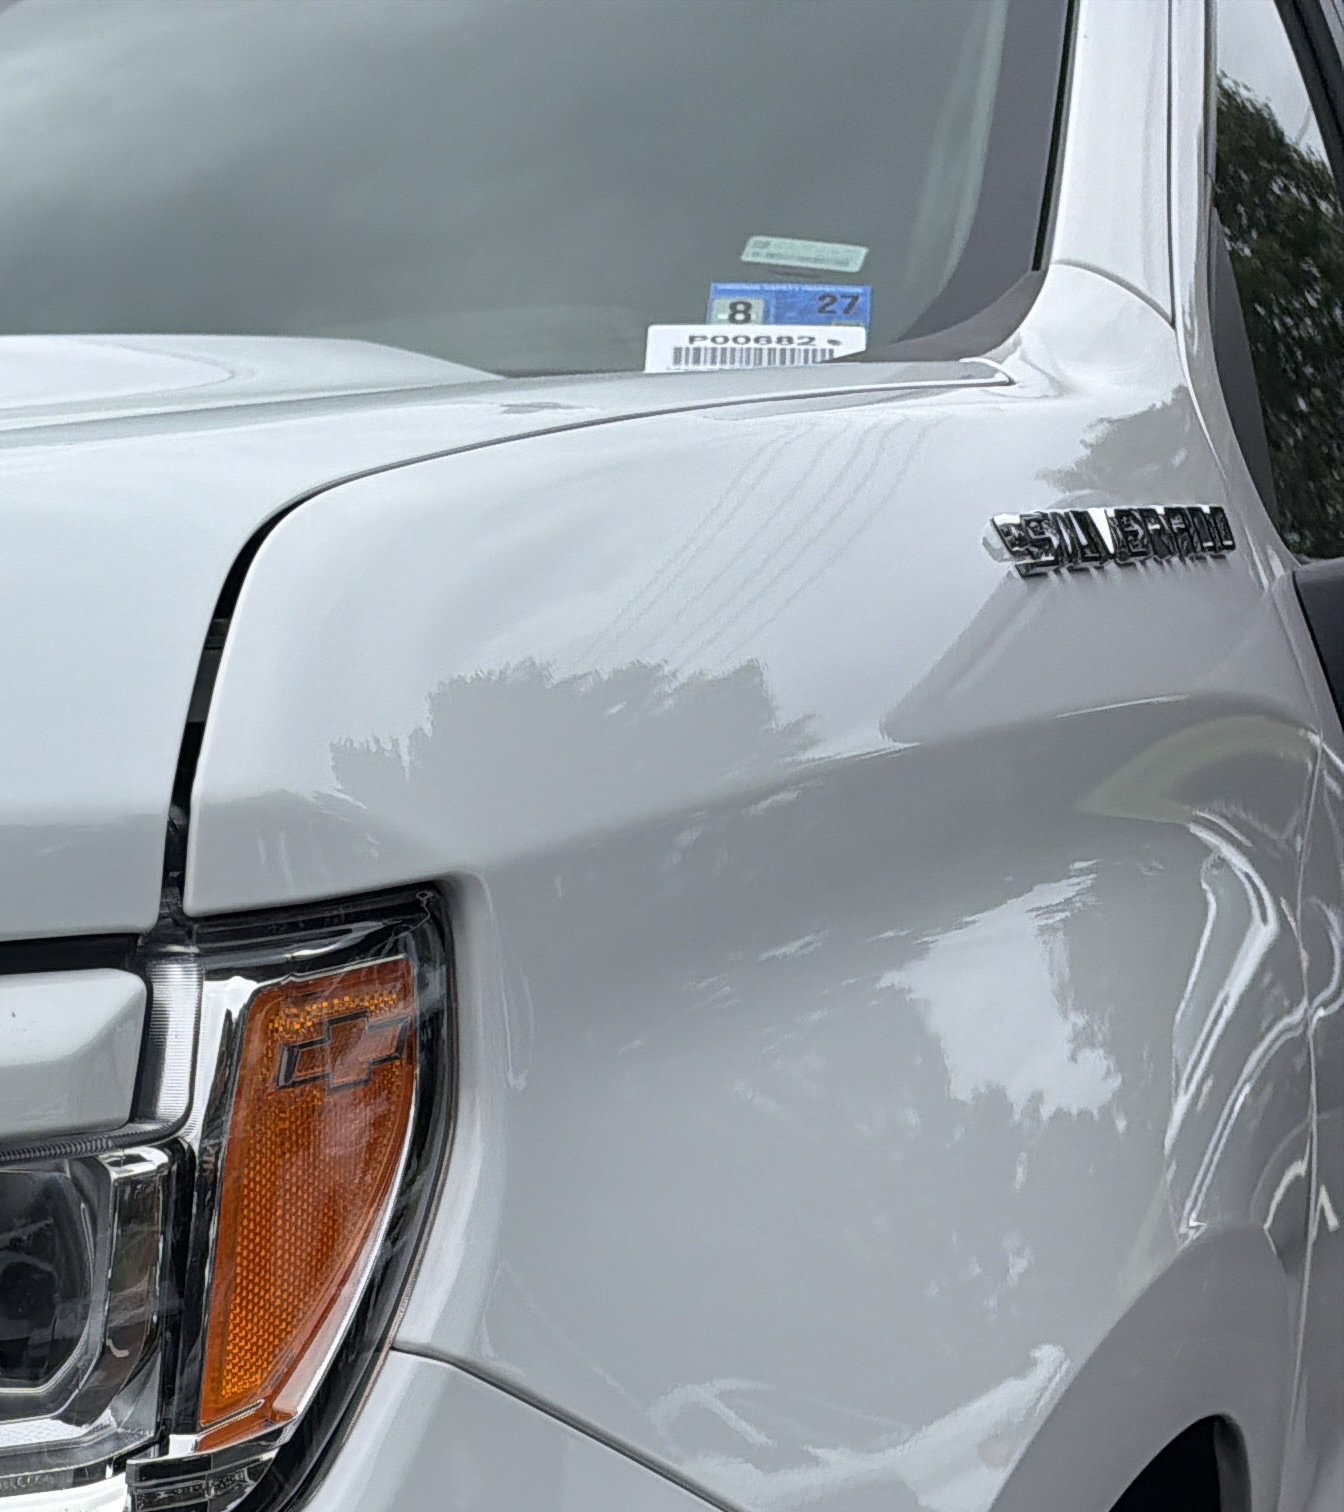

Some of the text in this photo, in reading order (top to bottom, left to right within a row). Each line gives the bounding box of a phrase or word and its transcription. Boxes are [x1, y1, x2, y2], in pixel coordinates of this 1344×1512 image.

[727, 300, 753, 325] 8
[816, 293, 861, 316] 27
[987, 505, 1236, 571] SILVERADO
